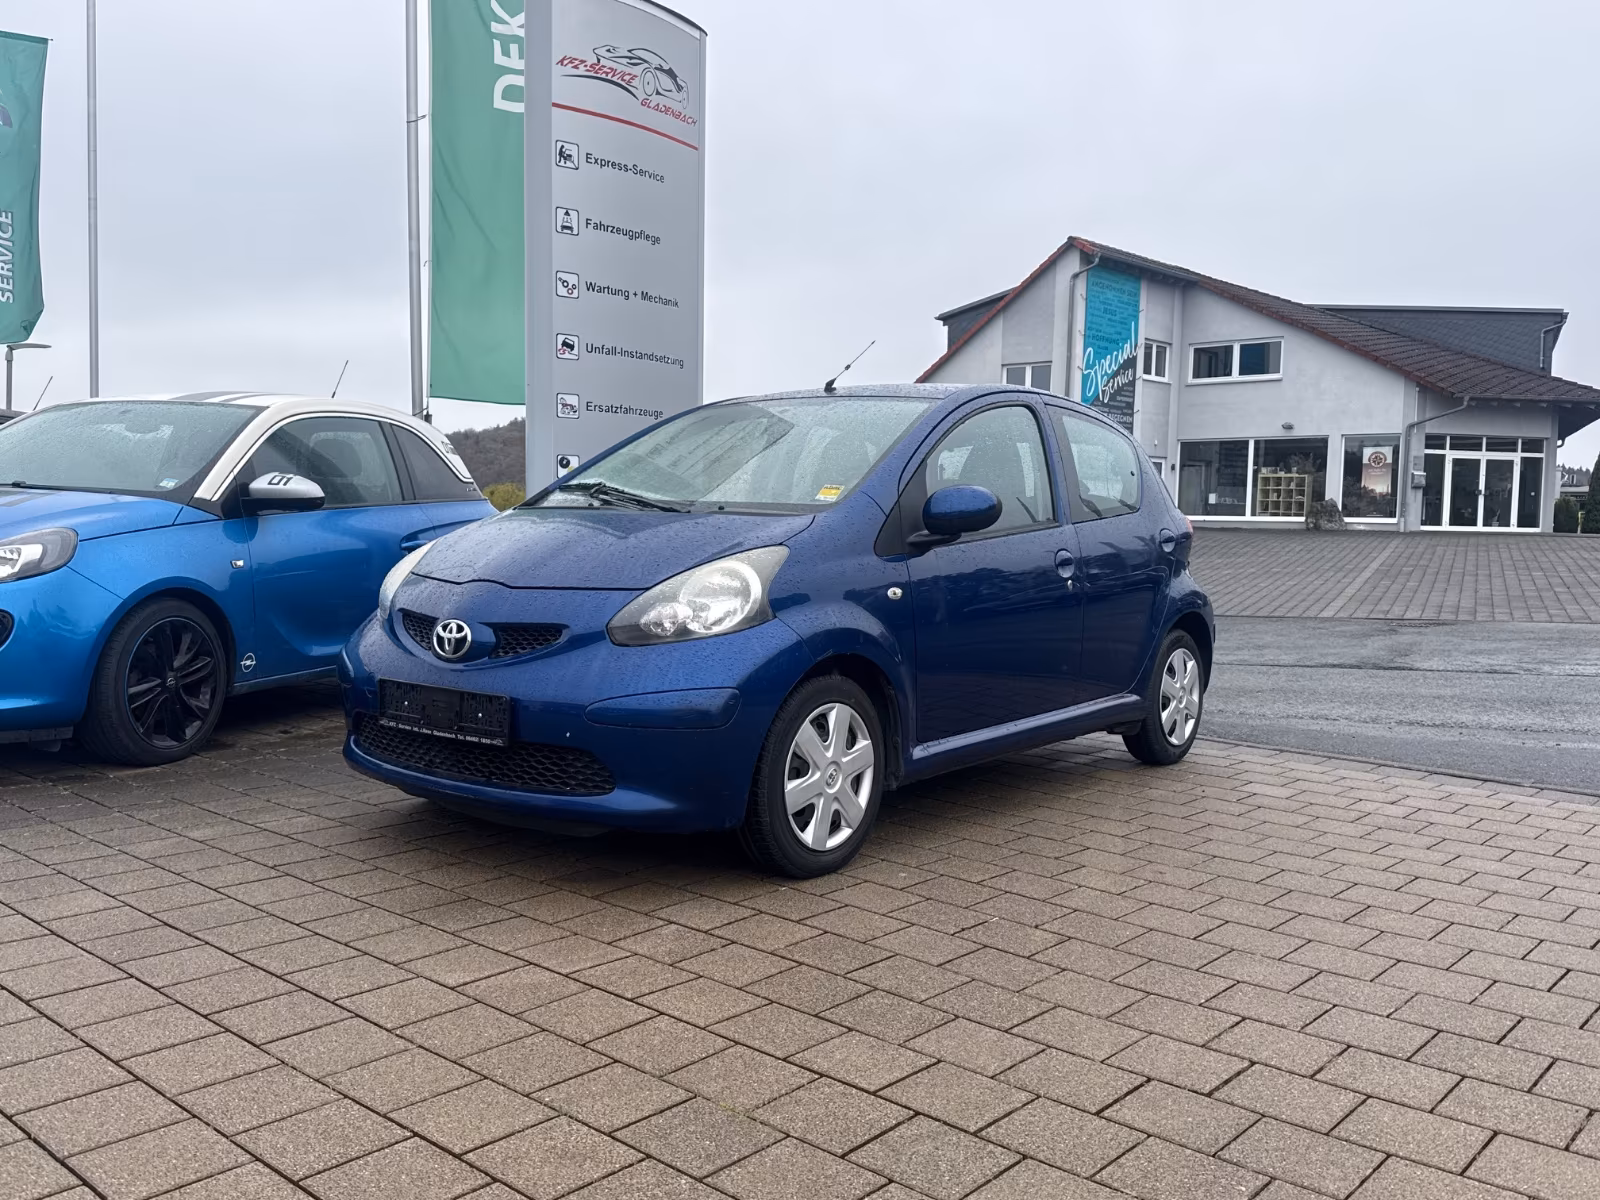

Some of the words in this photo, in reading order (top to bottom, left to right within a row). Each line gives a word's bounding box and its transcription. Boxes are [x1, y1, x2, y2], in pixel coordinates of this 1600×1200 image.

[556, 55, 639, 85] KFZ-SERVICE
[640, 97, 698, 127] GLADENBACH
[585, 152, 665, 184] Express-Service
[585, 218, 661, 246] Fahrzeugpflege
[0, 211, 13, 304] SERVICE
[585, 281, 630, 301] Wartung
[632, 290, 639, 299] +
[640, 291, 680, 309] Mechanik
[585, 343, 684, 369] Unfall-Instandsetzung
[1083, 321, 1139, 400] Special
[1102, 368, 1135, 403] Service
[585, 401, 664, 419] Ersatzfahrzeuge
